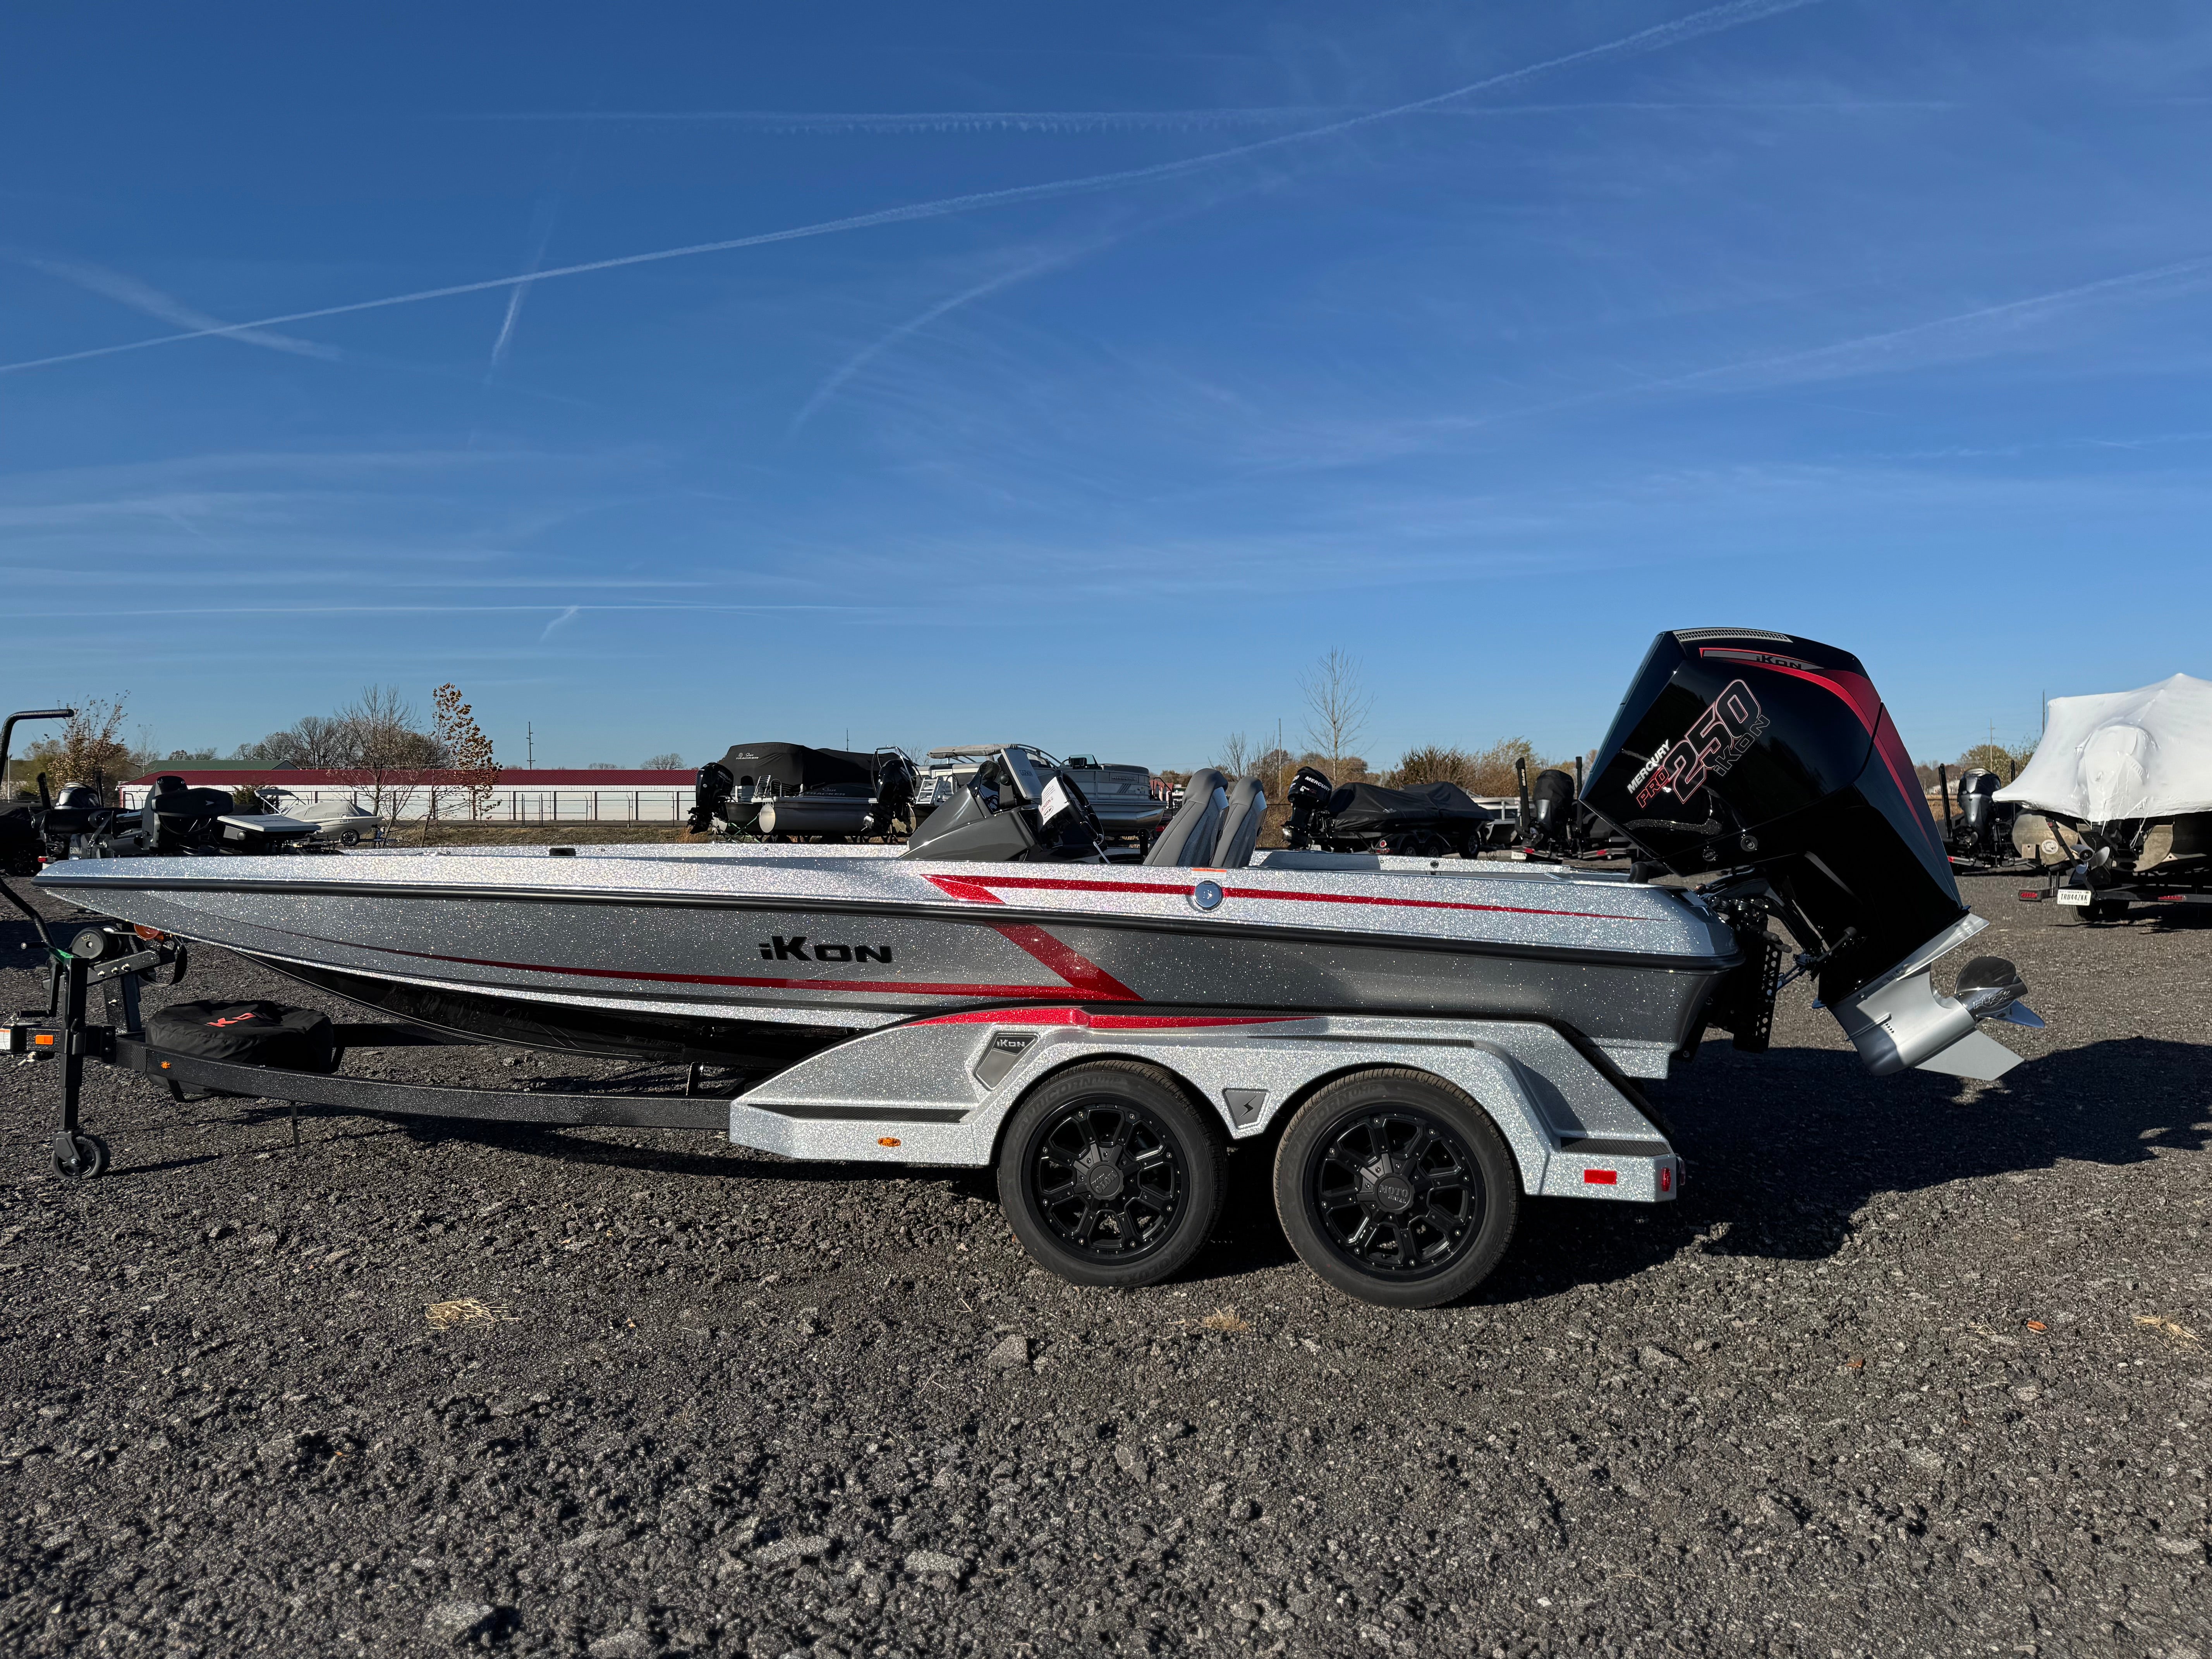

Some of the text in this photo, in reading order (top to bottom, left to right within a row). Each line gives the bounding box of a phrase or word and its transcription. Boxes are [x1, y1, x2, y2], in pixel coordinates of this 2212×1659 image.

[1756, 655, 1802, 670] iKON
[1662, 679, 1761, 805] 250
[1713, 714, 1770, 776] iKON
[1627, 739, 1670, 794] MERCURY
[1305, 776, 1331, 791] MERCURY
[1636, 767, 1669, 808] PRO
[759, 936, 892, 963] iKON
[997, 1039, 1025, 1047] iKON
[1379, 1184, 1408, 1197] MOTO
